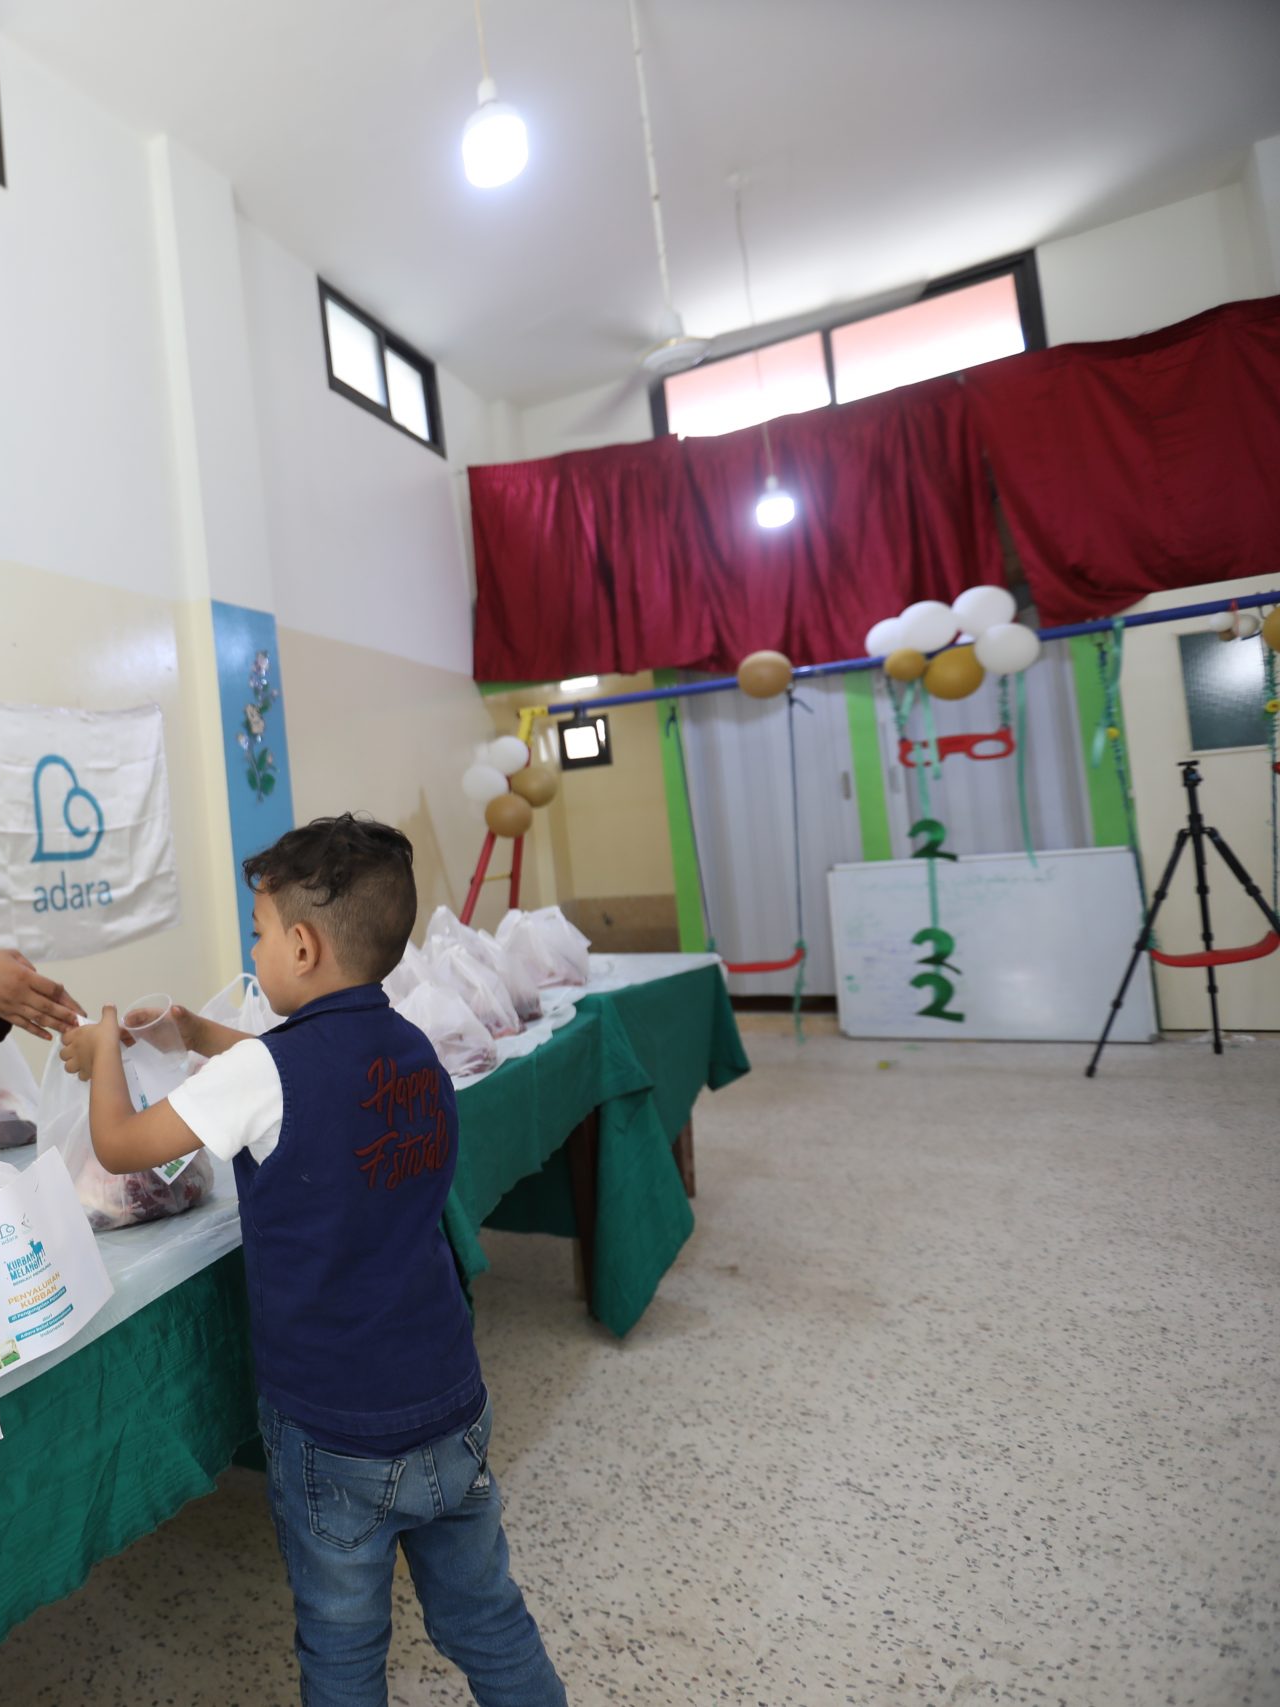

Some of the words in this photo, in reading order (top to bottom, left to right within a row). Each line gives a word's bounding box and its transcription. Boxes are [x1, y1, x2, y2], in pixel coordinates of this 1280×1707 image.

[32, 870, 113, 913] adara
[360, 1056, 440, 1126] Happy
[6, 1251, 36, 1272] KURBAN
[7, 1271, 61, 1305] PENYALURAN
[20, 1284, 58, 1309] KURBAN
